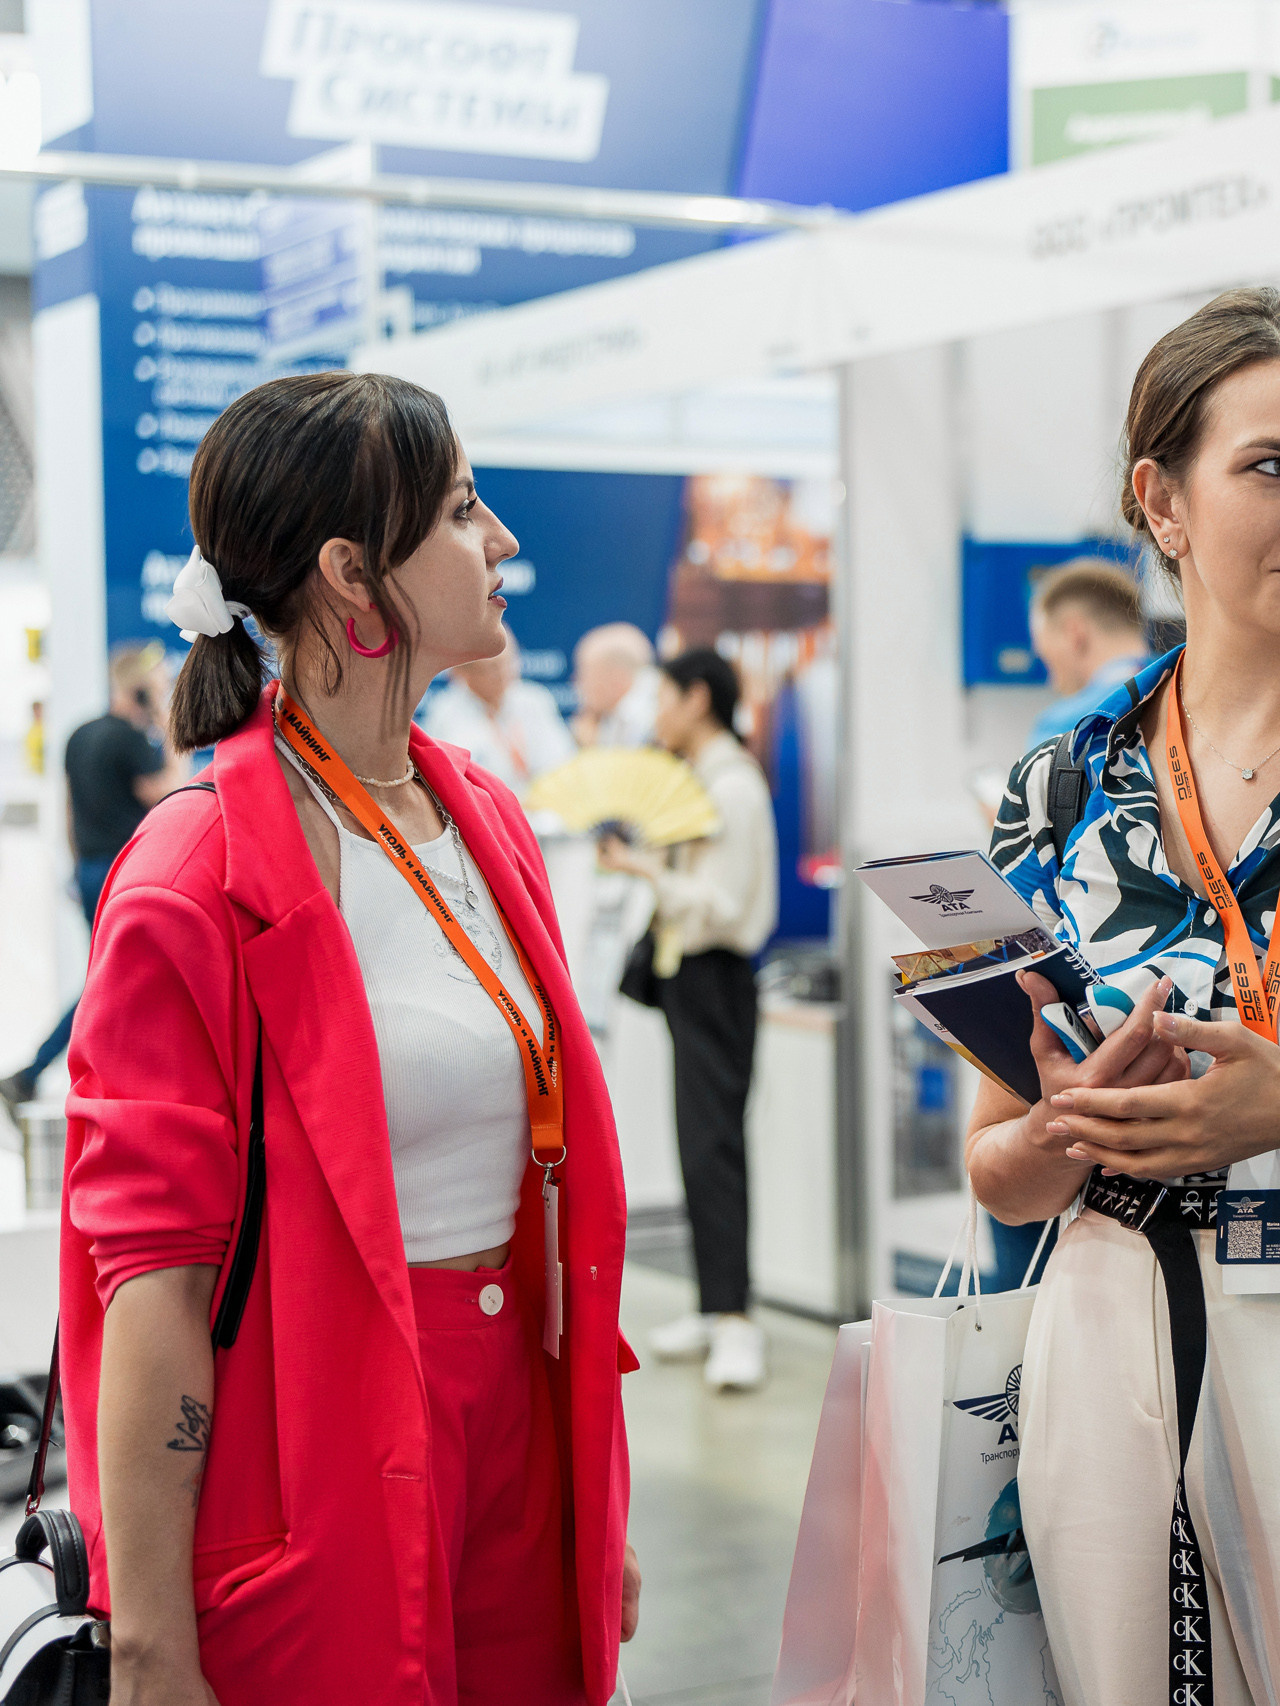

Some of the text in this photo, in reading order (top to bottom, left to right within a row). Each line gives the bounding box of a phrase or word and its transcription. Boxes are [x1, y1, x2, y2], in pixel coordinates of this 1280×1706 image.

[286, 713, 331, 762] МАЙНИНГ
[1169, 745, 1188, 801] DEES
[377, 830, 401, 859] РОССИИ
[379, 823, 454, 924] УГОЛЬ и МАЙНИНГ
[1196, 850, 1229, 911] DEES
[497, 996, 518, 1025] РОССИИ
[1233, 961, 1258, 1022] DEES
[498, 989, 550, 1097] УГОЛЬ и МАЙНИНГ
